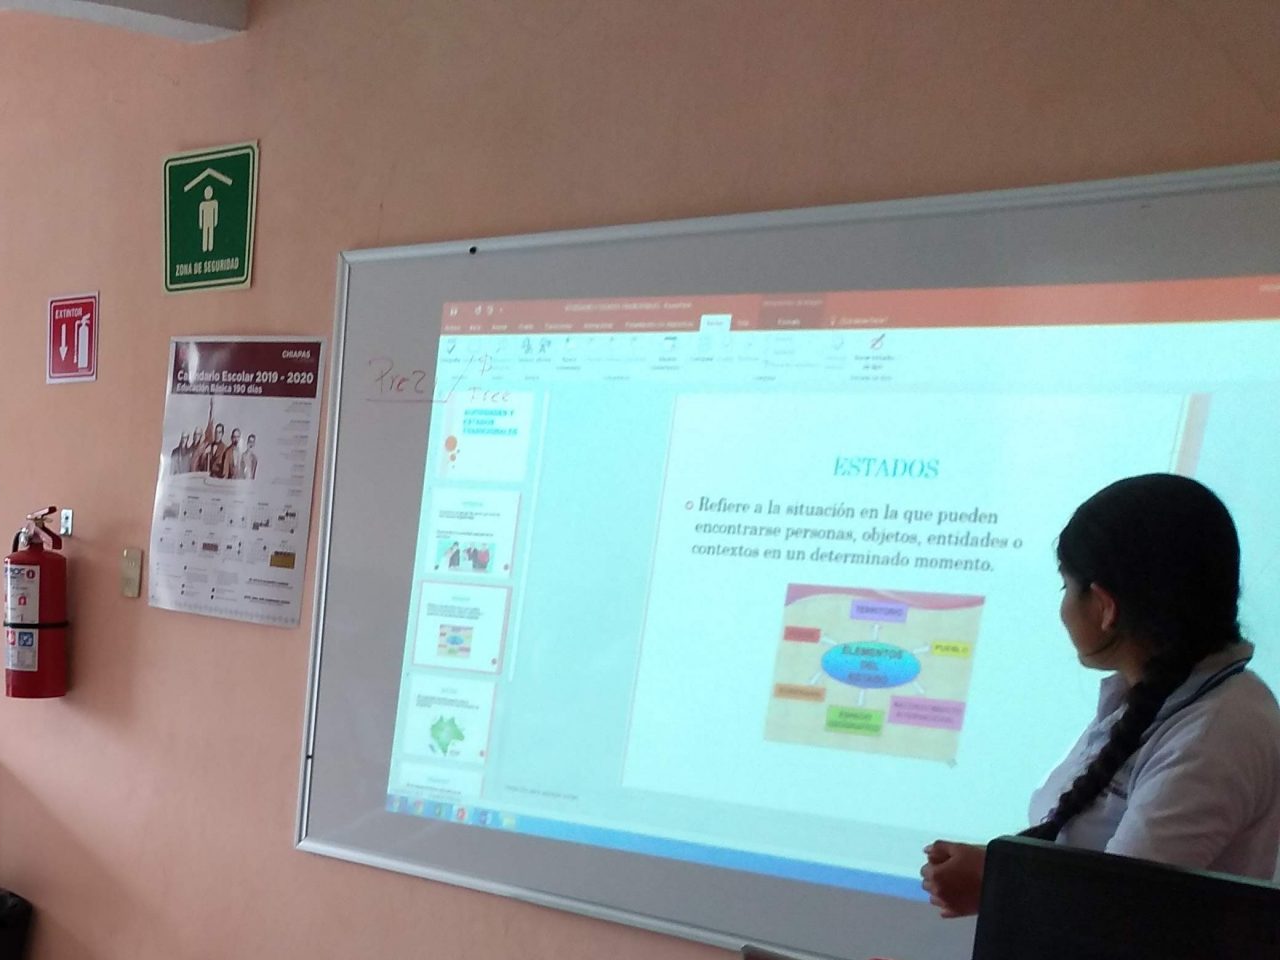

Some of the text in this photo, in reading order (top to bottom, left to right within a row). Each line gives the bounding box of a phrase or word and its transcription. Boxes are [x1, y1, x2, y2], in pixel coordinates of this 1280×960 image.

[176, 257, 240, 277] ZONA DE SEGURIDAD
[55, 307, 83, 319] EXTINTOR
[282, 350, 311, 359] CHIAPAS
[222, 371, 254, 383] Escolar
[256, 371, 279, 384] 2019
[287, 372, 314, 384] 2020
[233, 384, 246, 393] 190
[833, 456, 940, 478] ESTADOS
[698, 496, 998, 526] Refiere a la situación en la que pueden
[695, 521, 1023, 549] encontrarse personas, objetos, entidades o
[691, 542, 994, 572] contextos en un determinado momento.
